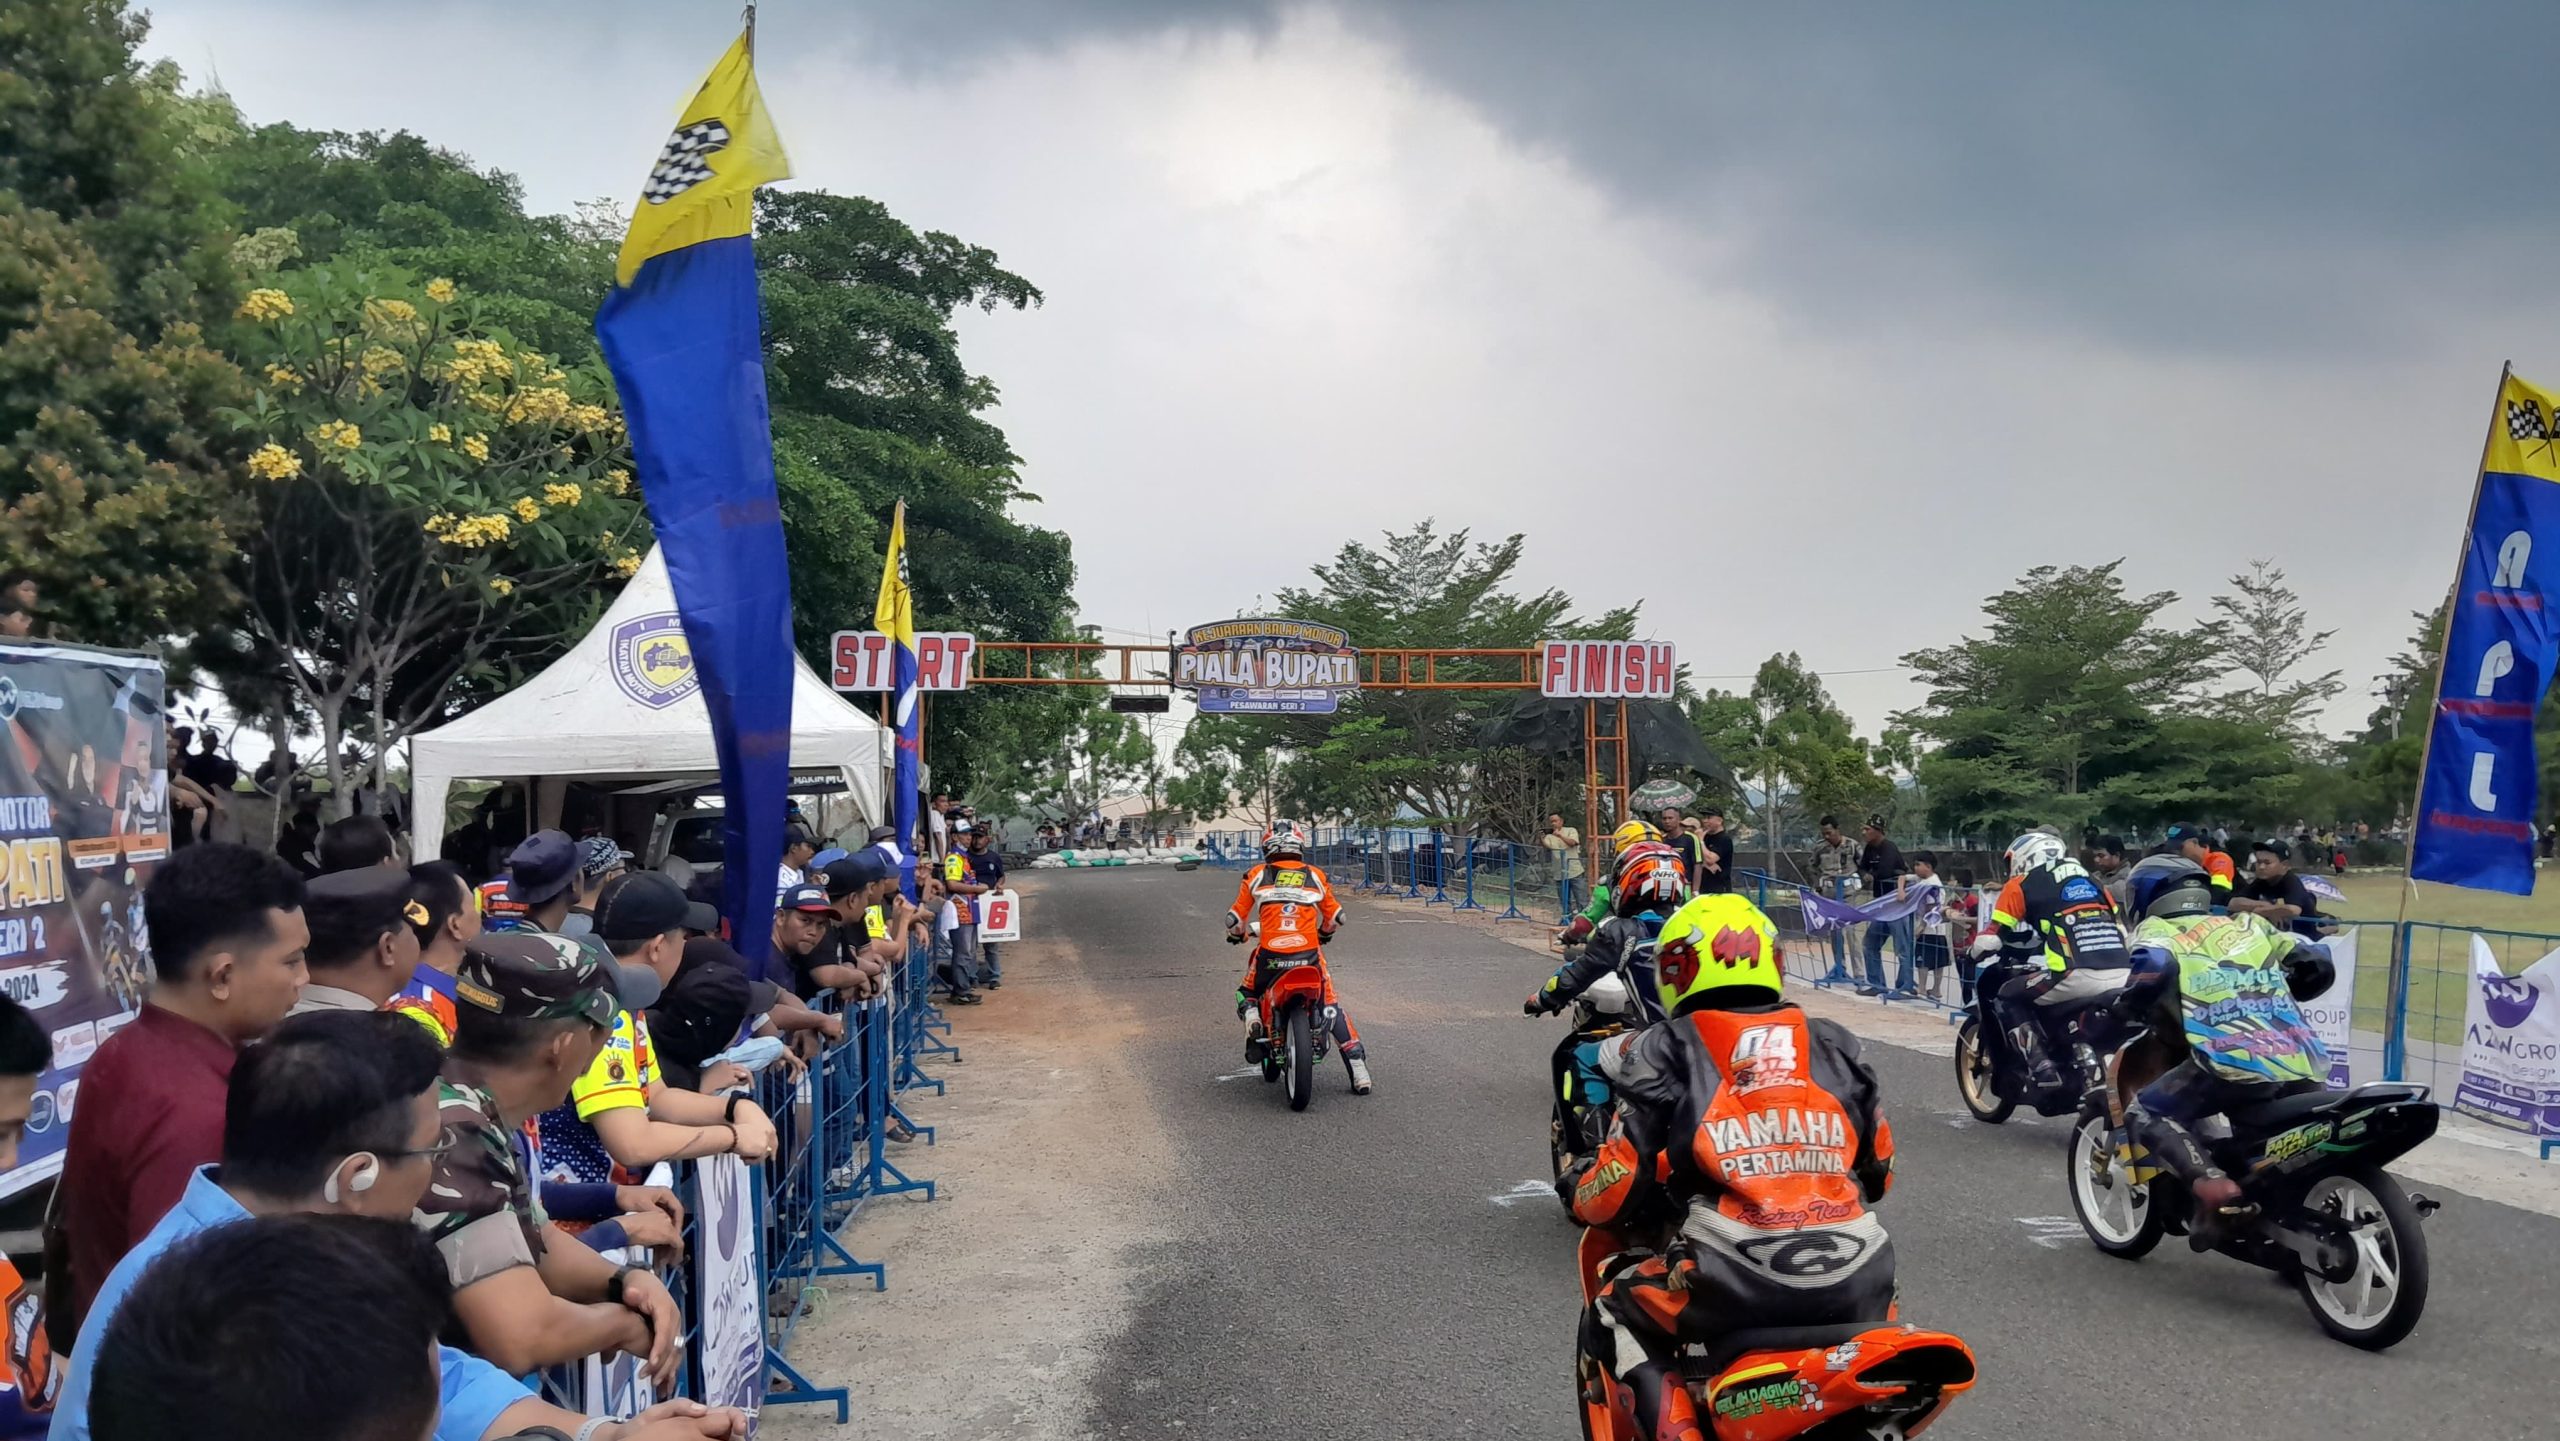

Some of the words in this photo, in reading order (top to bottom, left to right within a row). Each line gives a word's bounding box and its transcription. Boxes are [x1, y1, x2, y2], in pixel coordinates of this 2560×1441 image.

[1194, 623, 1261, 643] KEJUARAAN
[1264, 622, 1299, 636] BALAP
[1303, 625, 1342, 645] MOTOR
[834, 635, 970, 688] STRT
[1180, 651, 1256, 686] PIALA
[1265, 651, 1354, 687] BUPATI
[1546, 644, 1672, 693] FINISH
[1230, 701, 1278, 710] PESAWARAN
[1281, 702, 1298, 710] SERI
[0, 796, 50, 832] OTOR
[1276, 871, 1305, 887] 56
[987, 900, 1010, 930] 6
[31, 915, 46, 950] 2
[1703, 1108, 1846, 1154] YAMAHA
[1720, 1151, 1846, 1181] PERTAMINA
[1737, 1203, 1809, 1230] Racing
